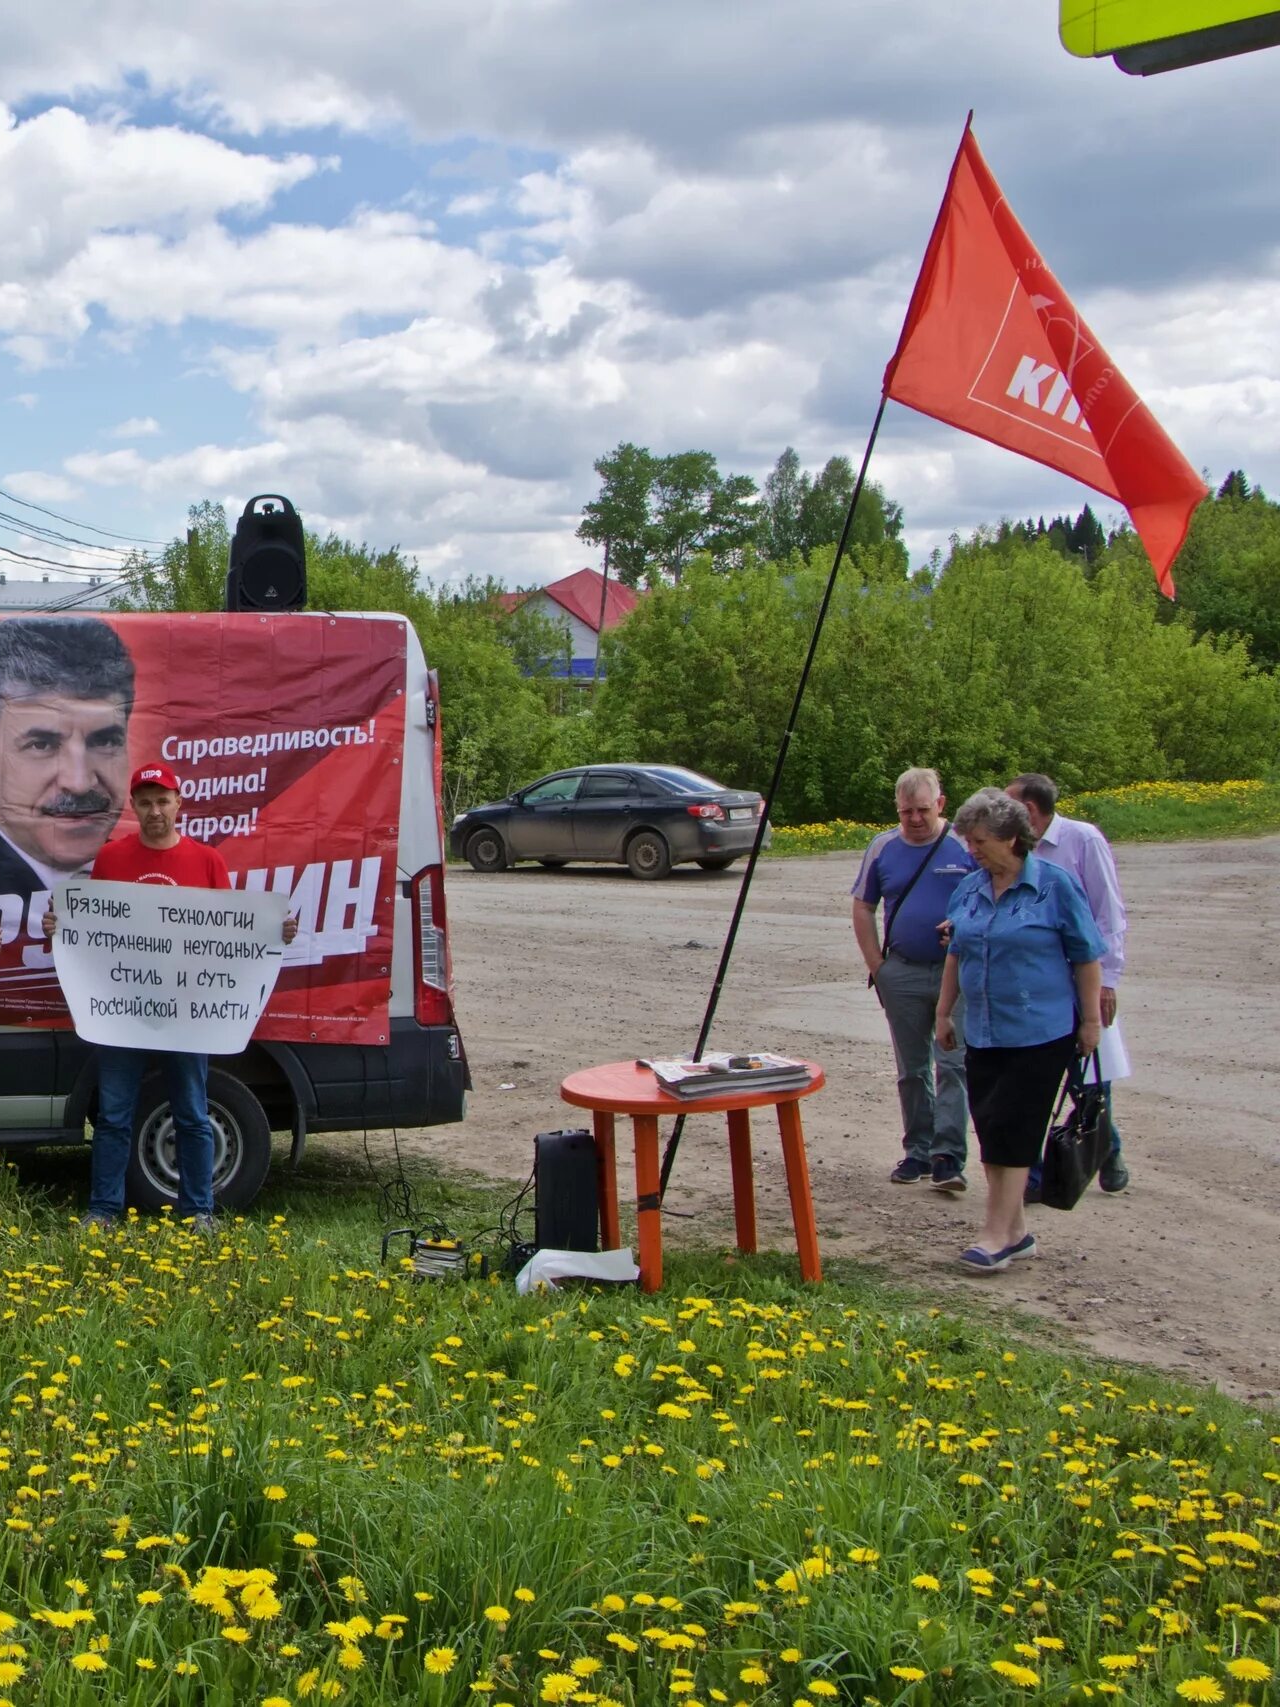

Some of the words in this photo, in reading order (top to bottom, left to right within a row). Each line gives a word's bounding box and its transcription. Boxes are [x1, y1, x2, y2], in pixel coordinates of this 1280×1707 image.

[161, 719, 376, 765] Справедливость!
[66, 888, 131, 919] Грязные
[158, 906, 255, 931] технологии
[62, 928, 79, 946] по
[86, 930, 172, 954] устранению
